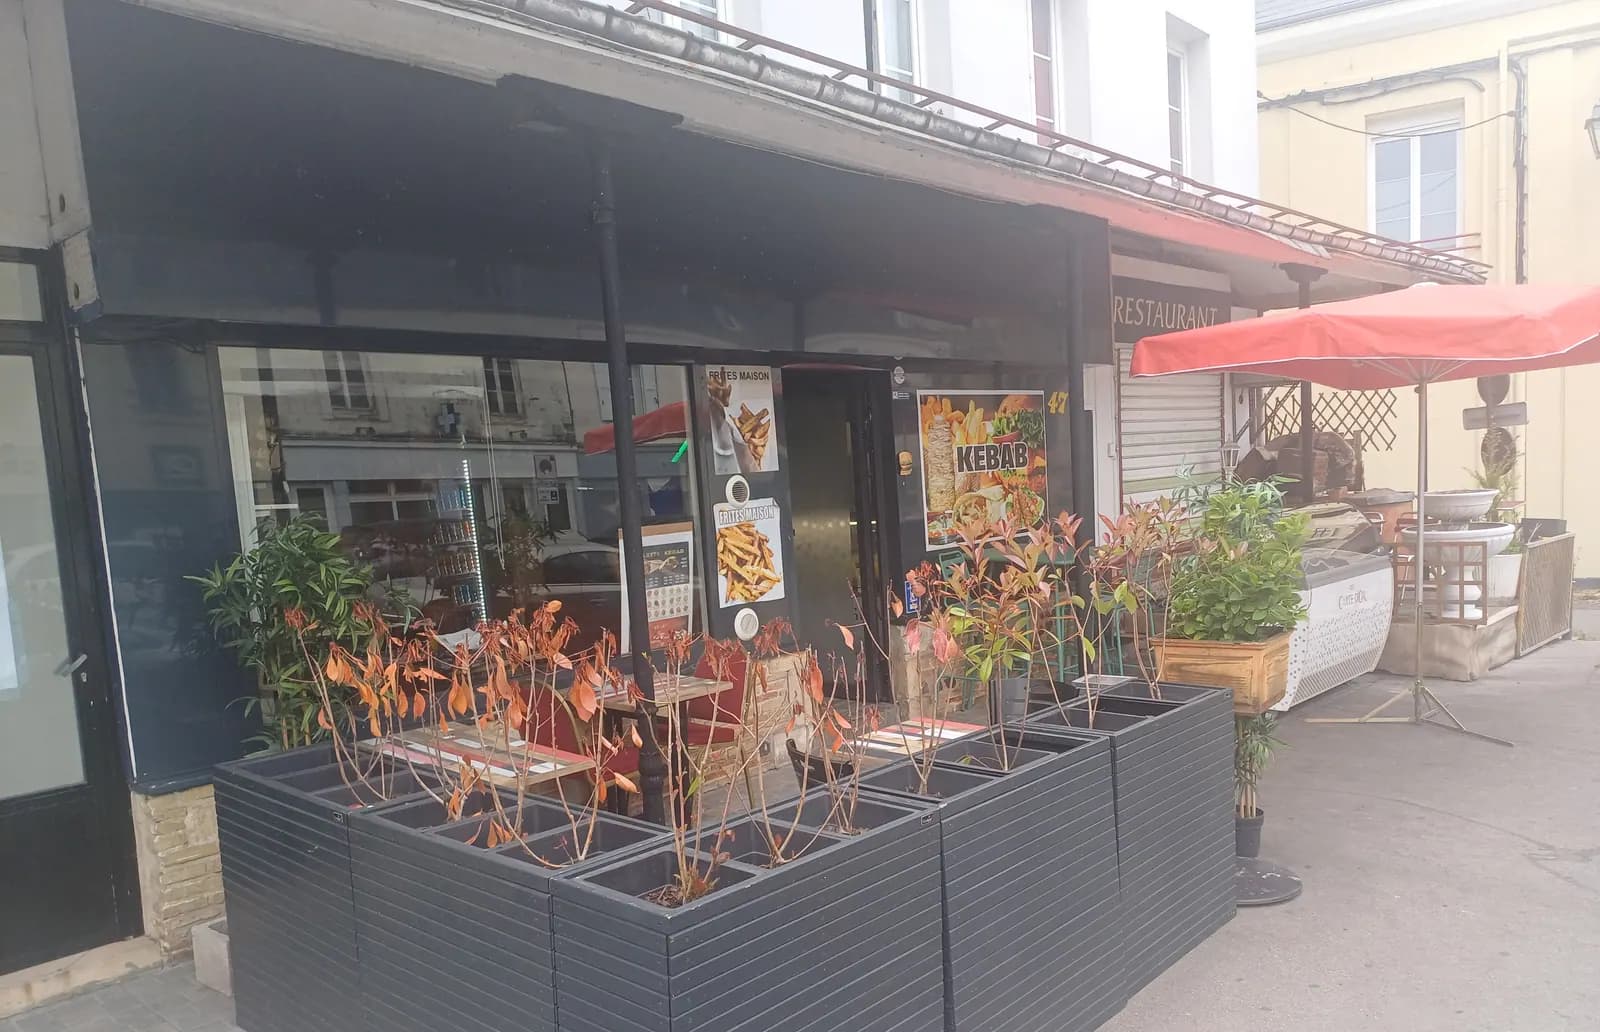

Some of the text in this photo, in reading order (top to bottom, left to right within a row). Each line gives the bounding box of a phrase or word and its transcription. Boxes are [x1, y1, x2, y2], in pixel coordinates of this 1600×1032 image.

[1113, 295, 1218, 330] RESTAURANT
[739, 371, 770, 381] MAISON
[1047, 391, 1069, 414] 47
[955, 441, 1029, 473] KEBAB
[719, 504, 775, 525] FRITES MAISON
